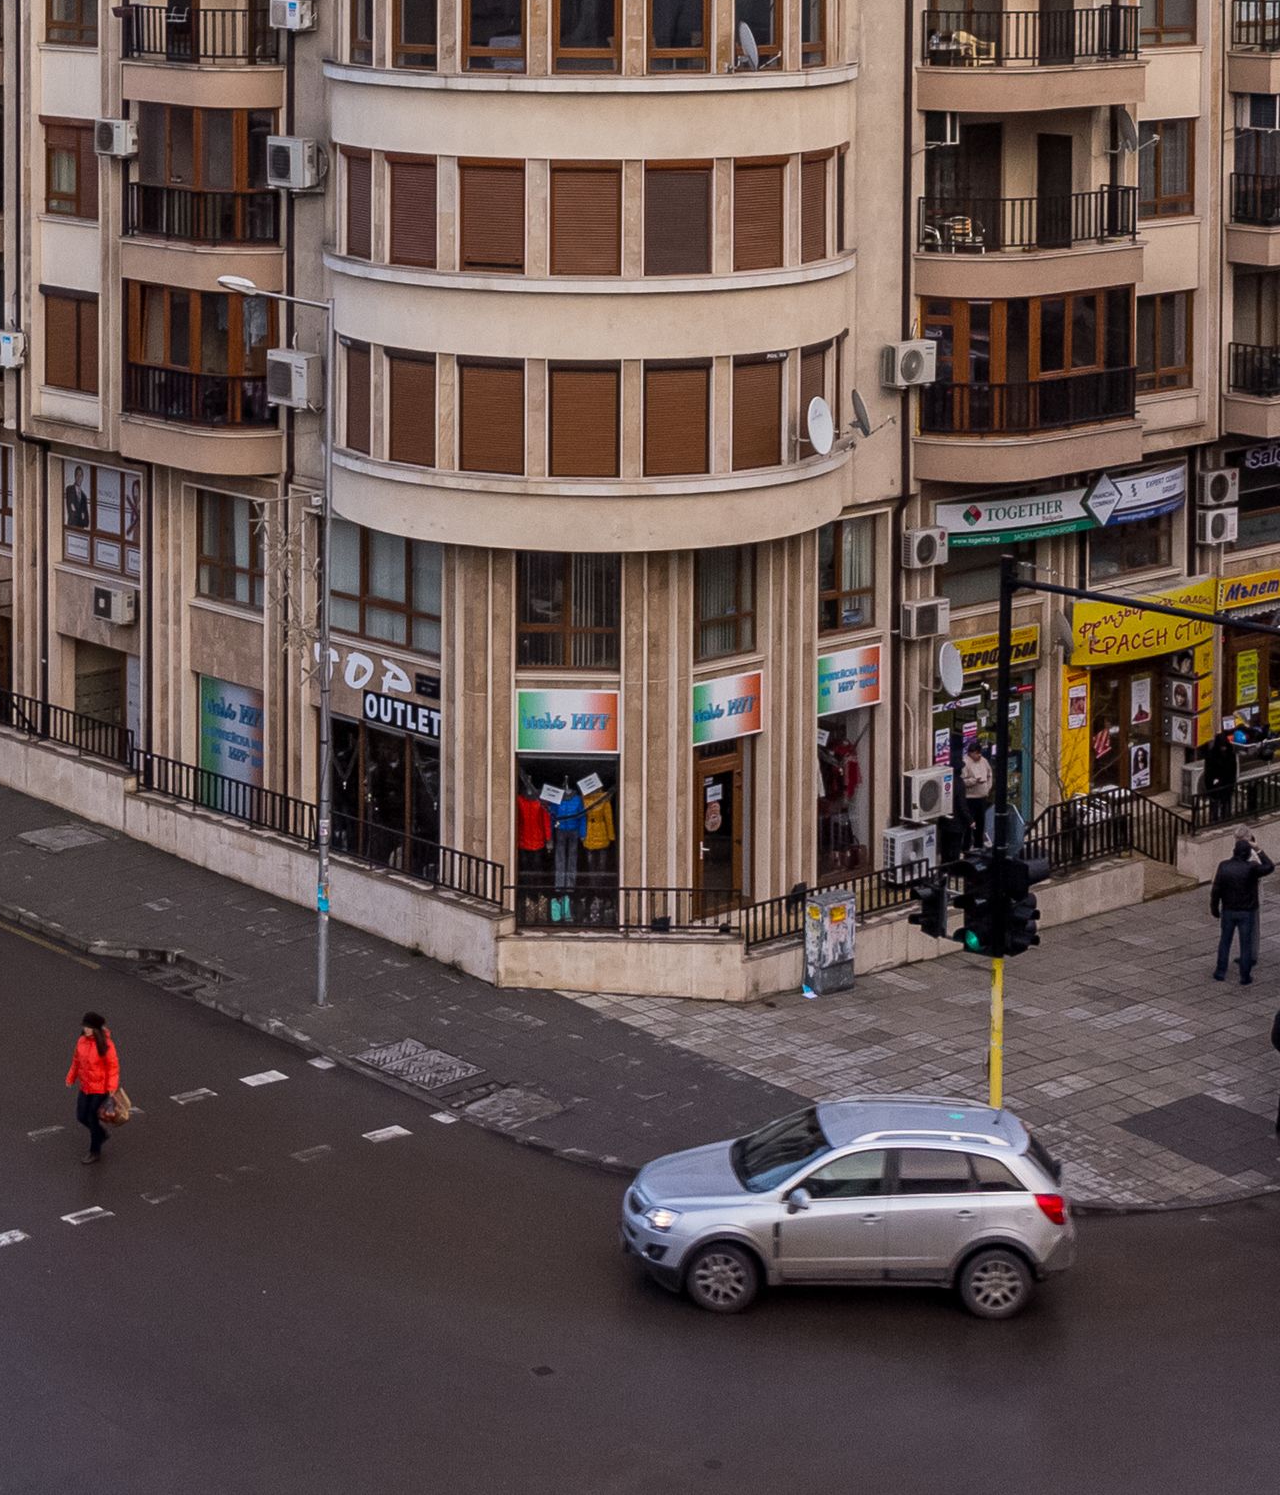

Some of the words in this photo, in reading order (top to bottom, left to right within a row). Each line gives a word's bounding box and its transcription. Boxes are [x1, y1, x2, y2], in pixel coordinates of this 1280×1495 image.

[984, 499, 1063, 522] TOGETHER
[1088, 627, 1169, 655] КРАСЕН
[365, 693, 441, 737] OUTLET
